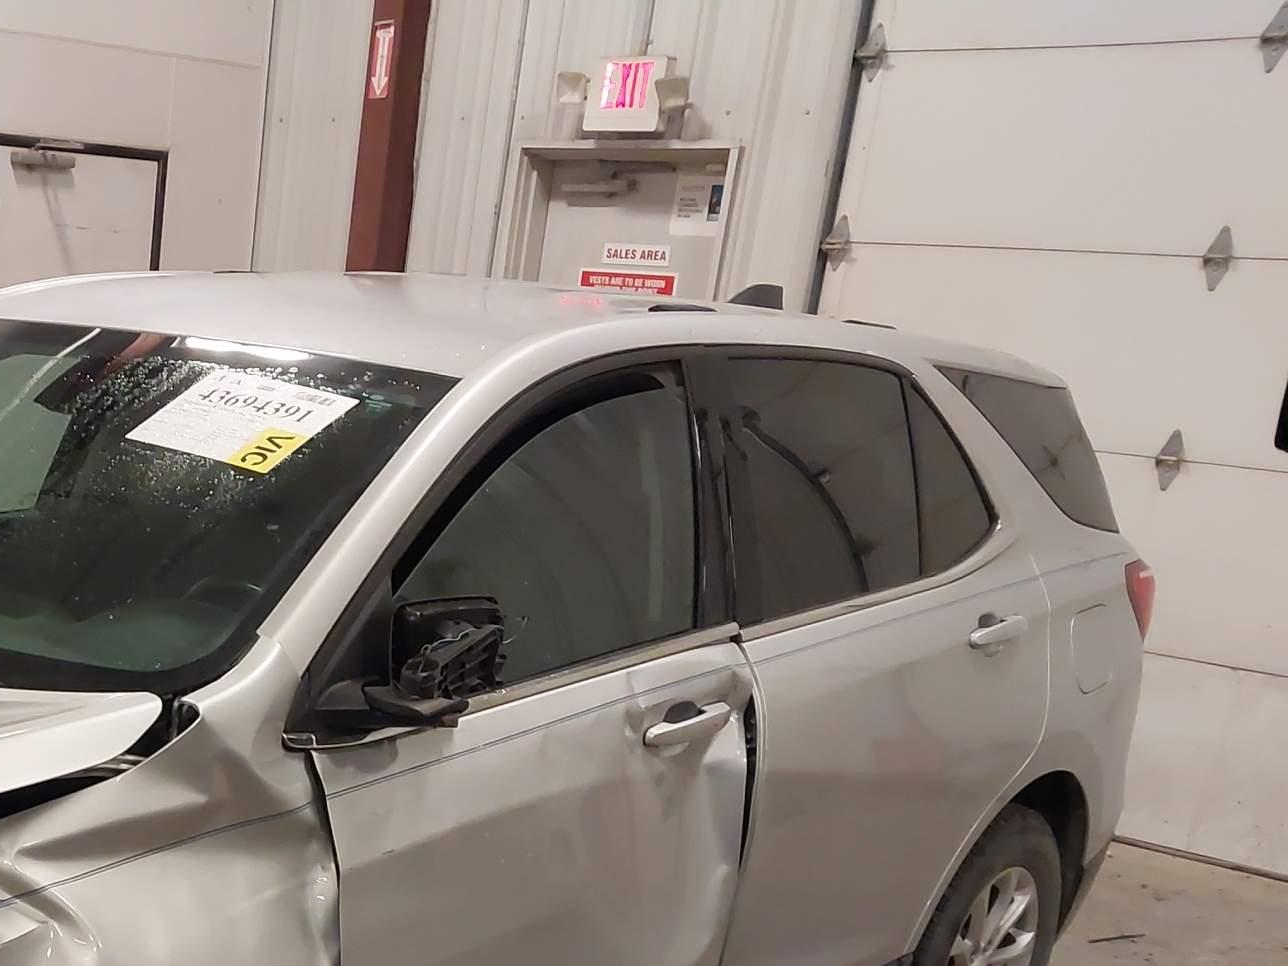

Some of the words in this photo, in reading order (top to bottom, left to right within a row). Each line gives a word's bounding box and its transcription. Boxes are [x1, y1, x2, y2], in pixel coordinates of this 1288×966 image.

[600, 62, 656, 109] EXIT
[606, 248, 637, 260] SALES
[639, 249, 666, 261] AREA
[625, 277, 634, 287] TO
[199, 387, 315, 424] 43694391
[240, 435, 297, 467] VIC
